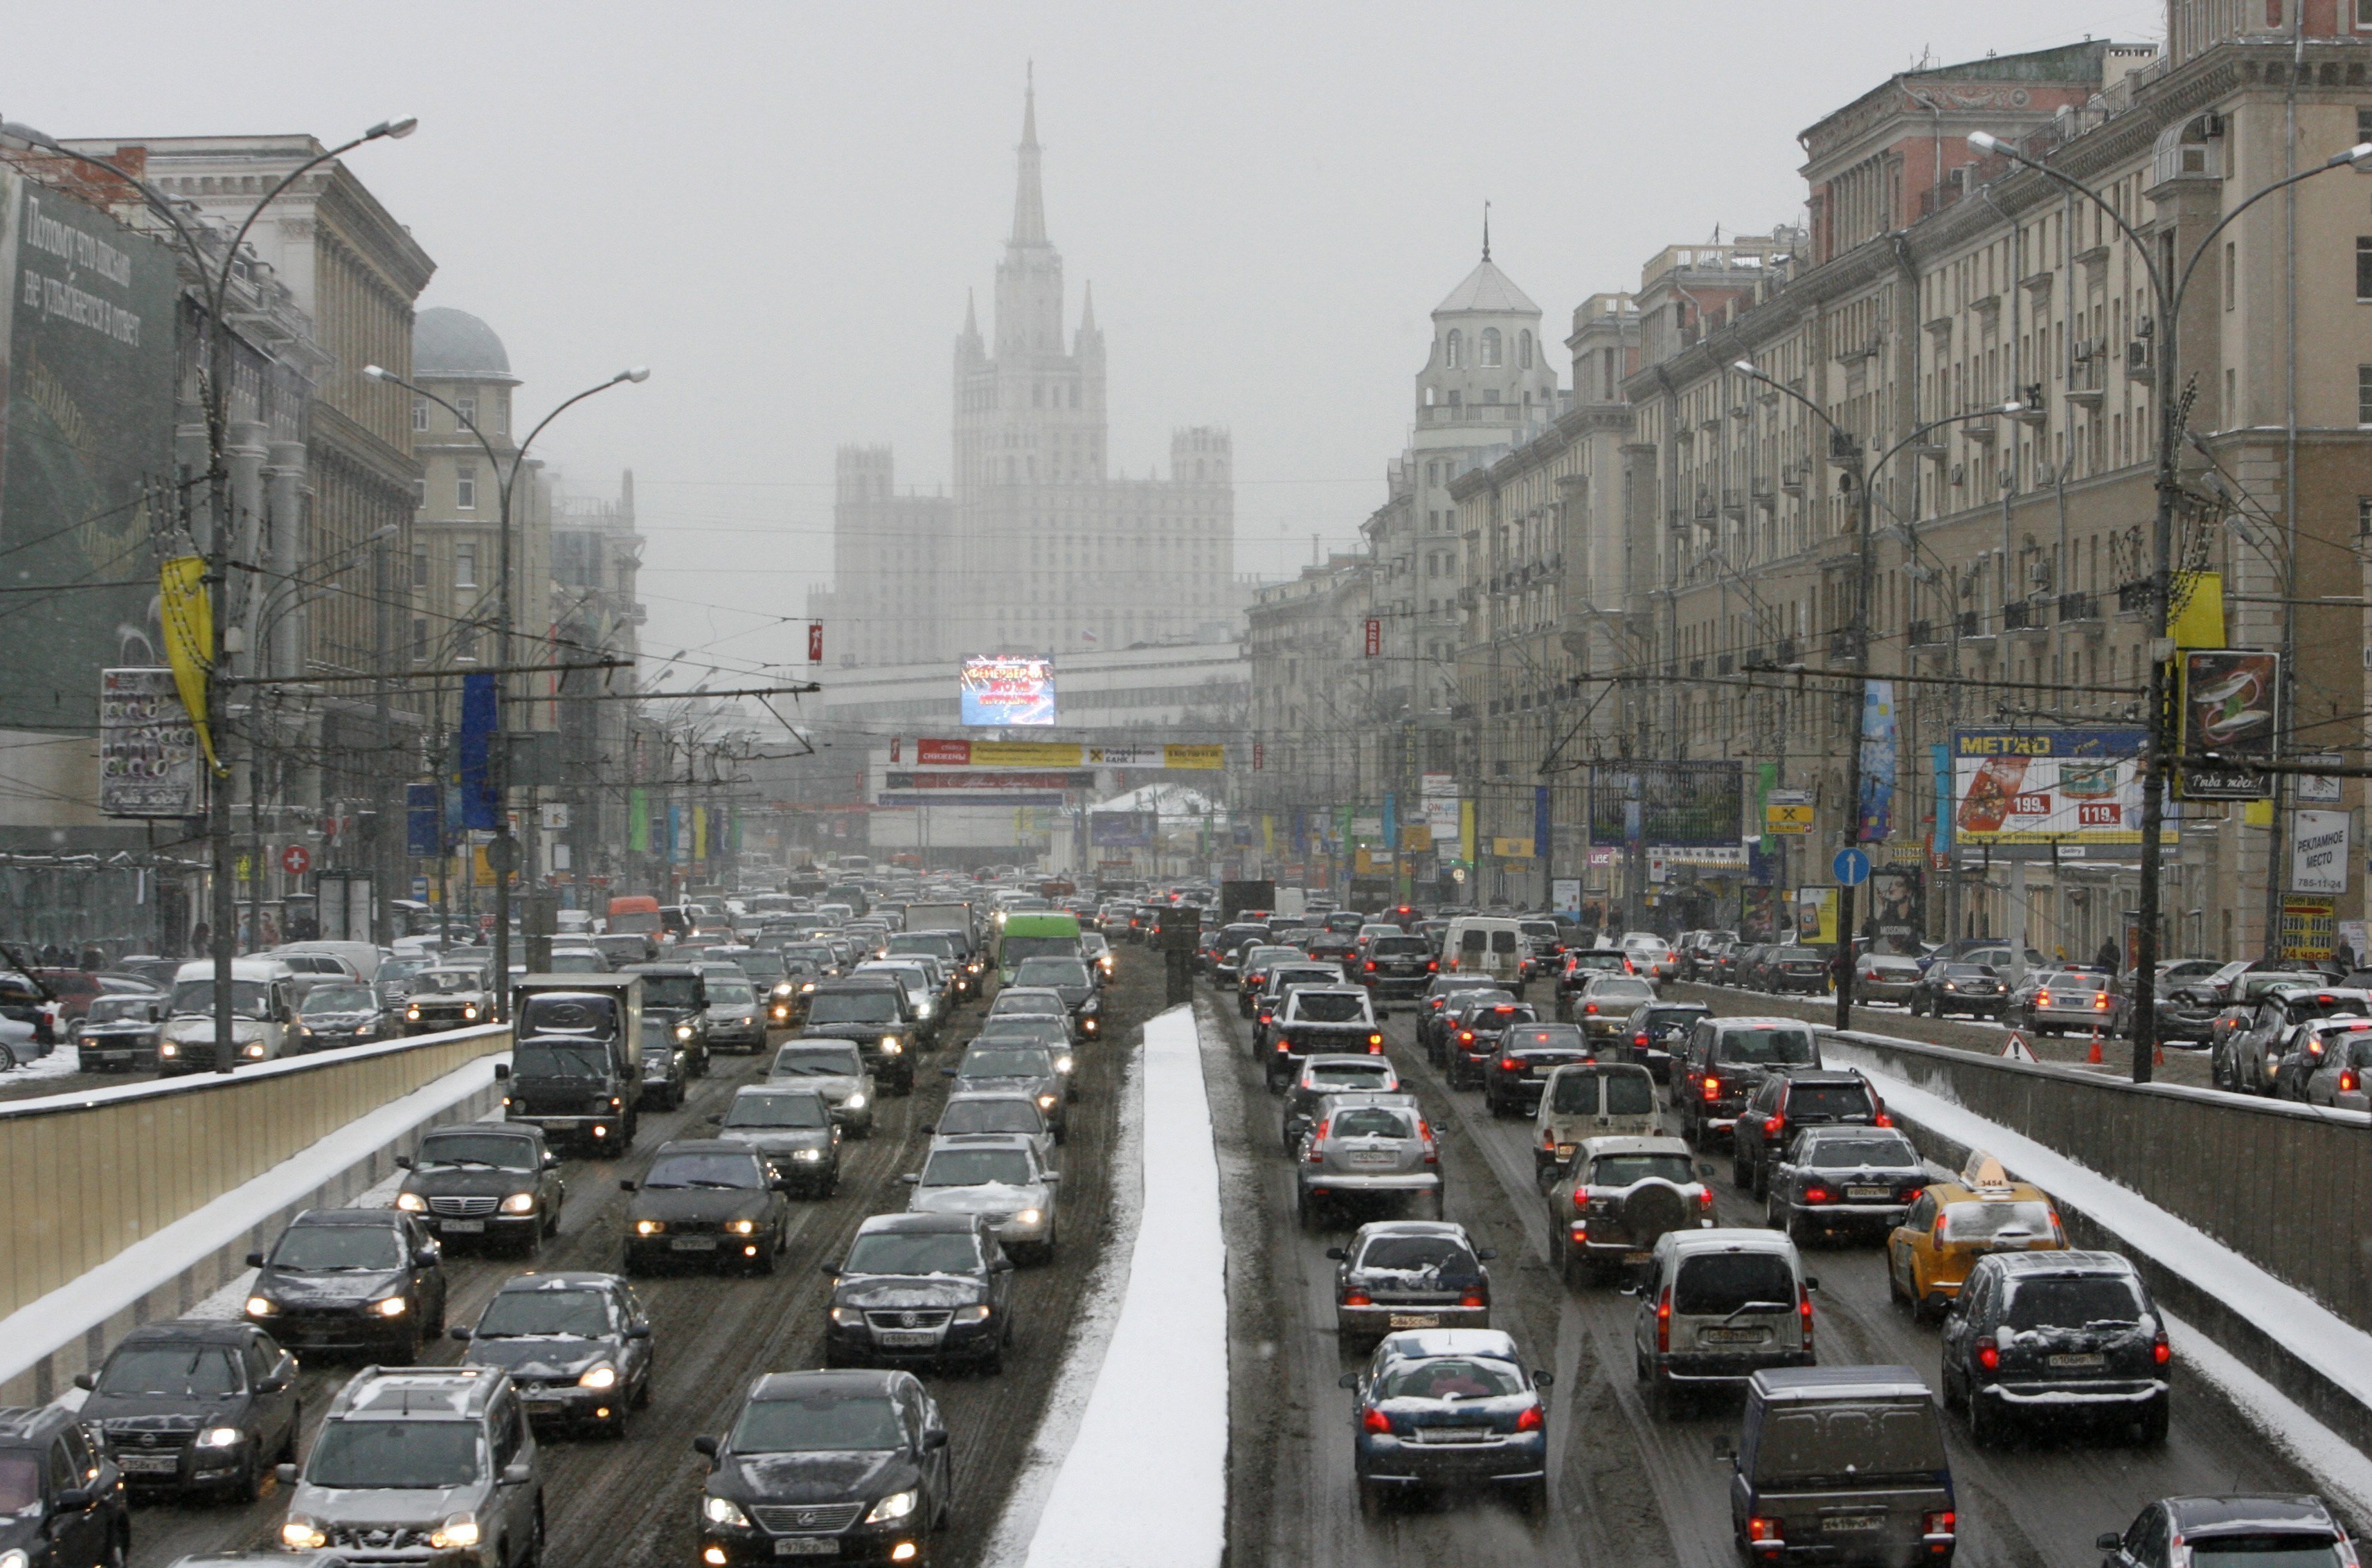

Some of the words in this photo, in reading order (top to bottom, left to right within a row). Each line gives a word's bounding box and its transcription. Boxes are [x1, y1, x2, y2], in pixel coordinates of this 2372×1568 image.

[27, 195, 76, 271] Потому
[24, 269, 41, 308] не
[1960, 737, 2051, 755] METRO
[922, 753, 967, 761] СНИЖЕНЫ
[2297, 830, 2344, 854] РЕКЛАМНОЕ
[2306, 851, 2333, 869] МЕСТО
[2298, 878, 2342, 889] 785-11-24
[2284, 896, 2306, 905] ОБМЕН
[1880, 926, 1912, 935] MOSCHINO
[2282, 948, 2297, 959] 24
[2300, 950, 2330, 960] часа
